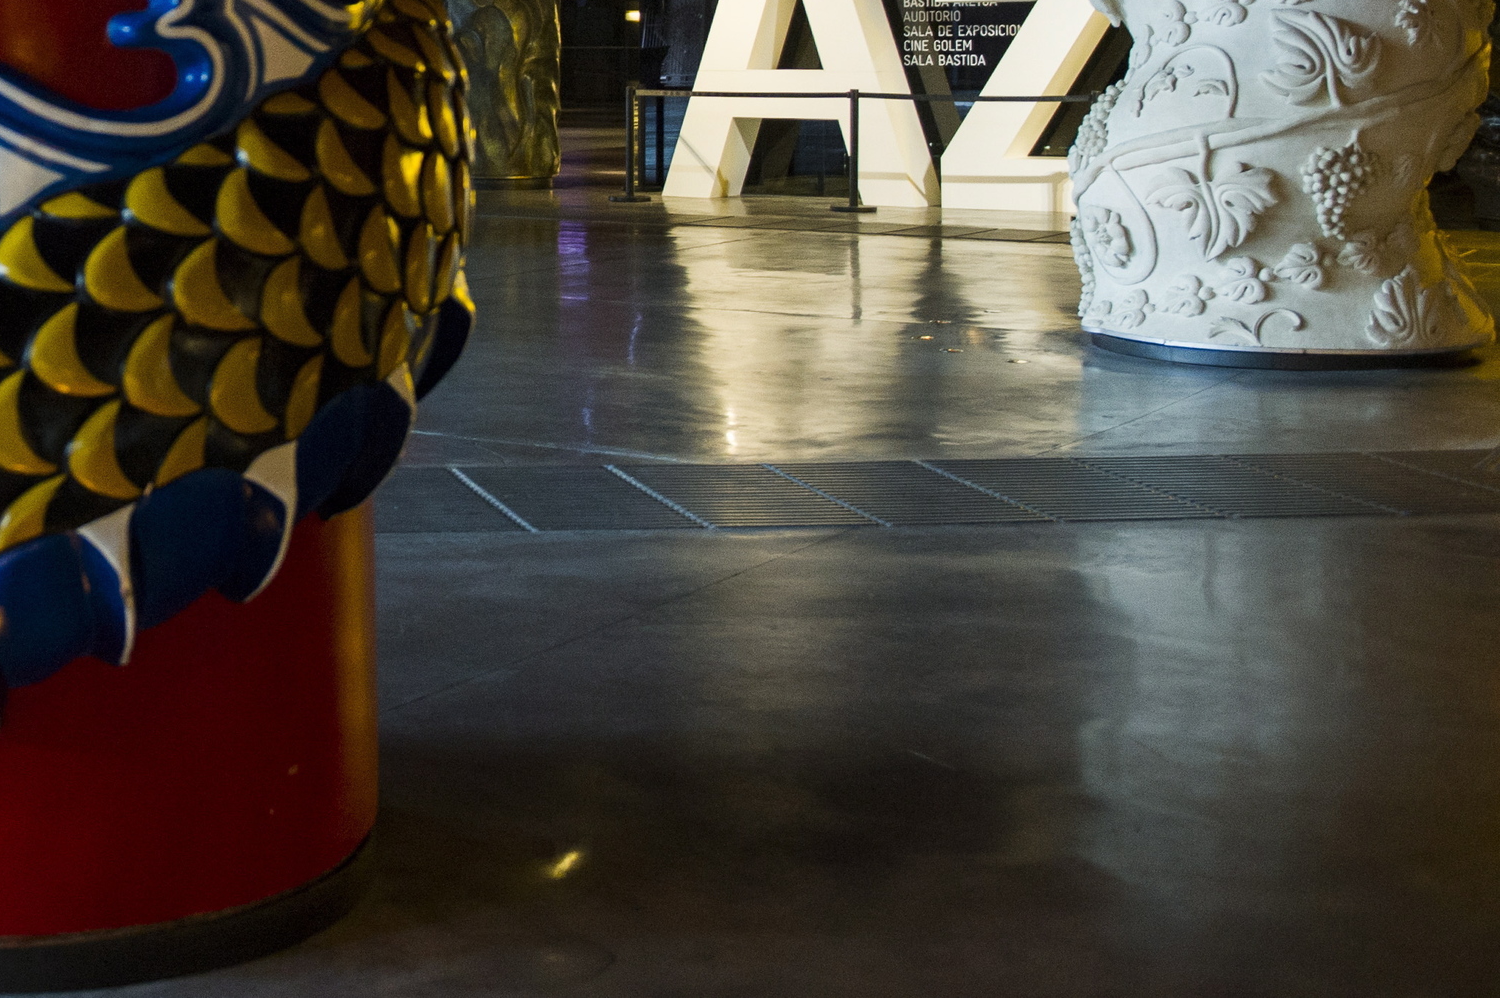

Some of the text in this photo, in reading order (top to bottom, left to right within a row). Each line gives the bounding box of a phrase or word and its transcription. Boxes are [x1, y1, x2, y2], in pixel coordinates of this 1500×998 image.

[903, 10, 961, 22] AUDITORIO
[903, 25, 934, 37] SALA
[937, 25, 953, 37] DE
[903, 39, 973, 51] CINE GOLEM
[903, 54, 986, 66] SALA BASTIDA
